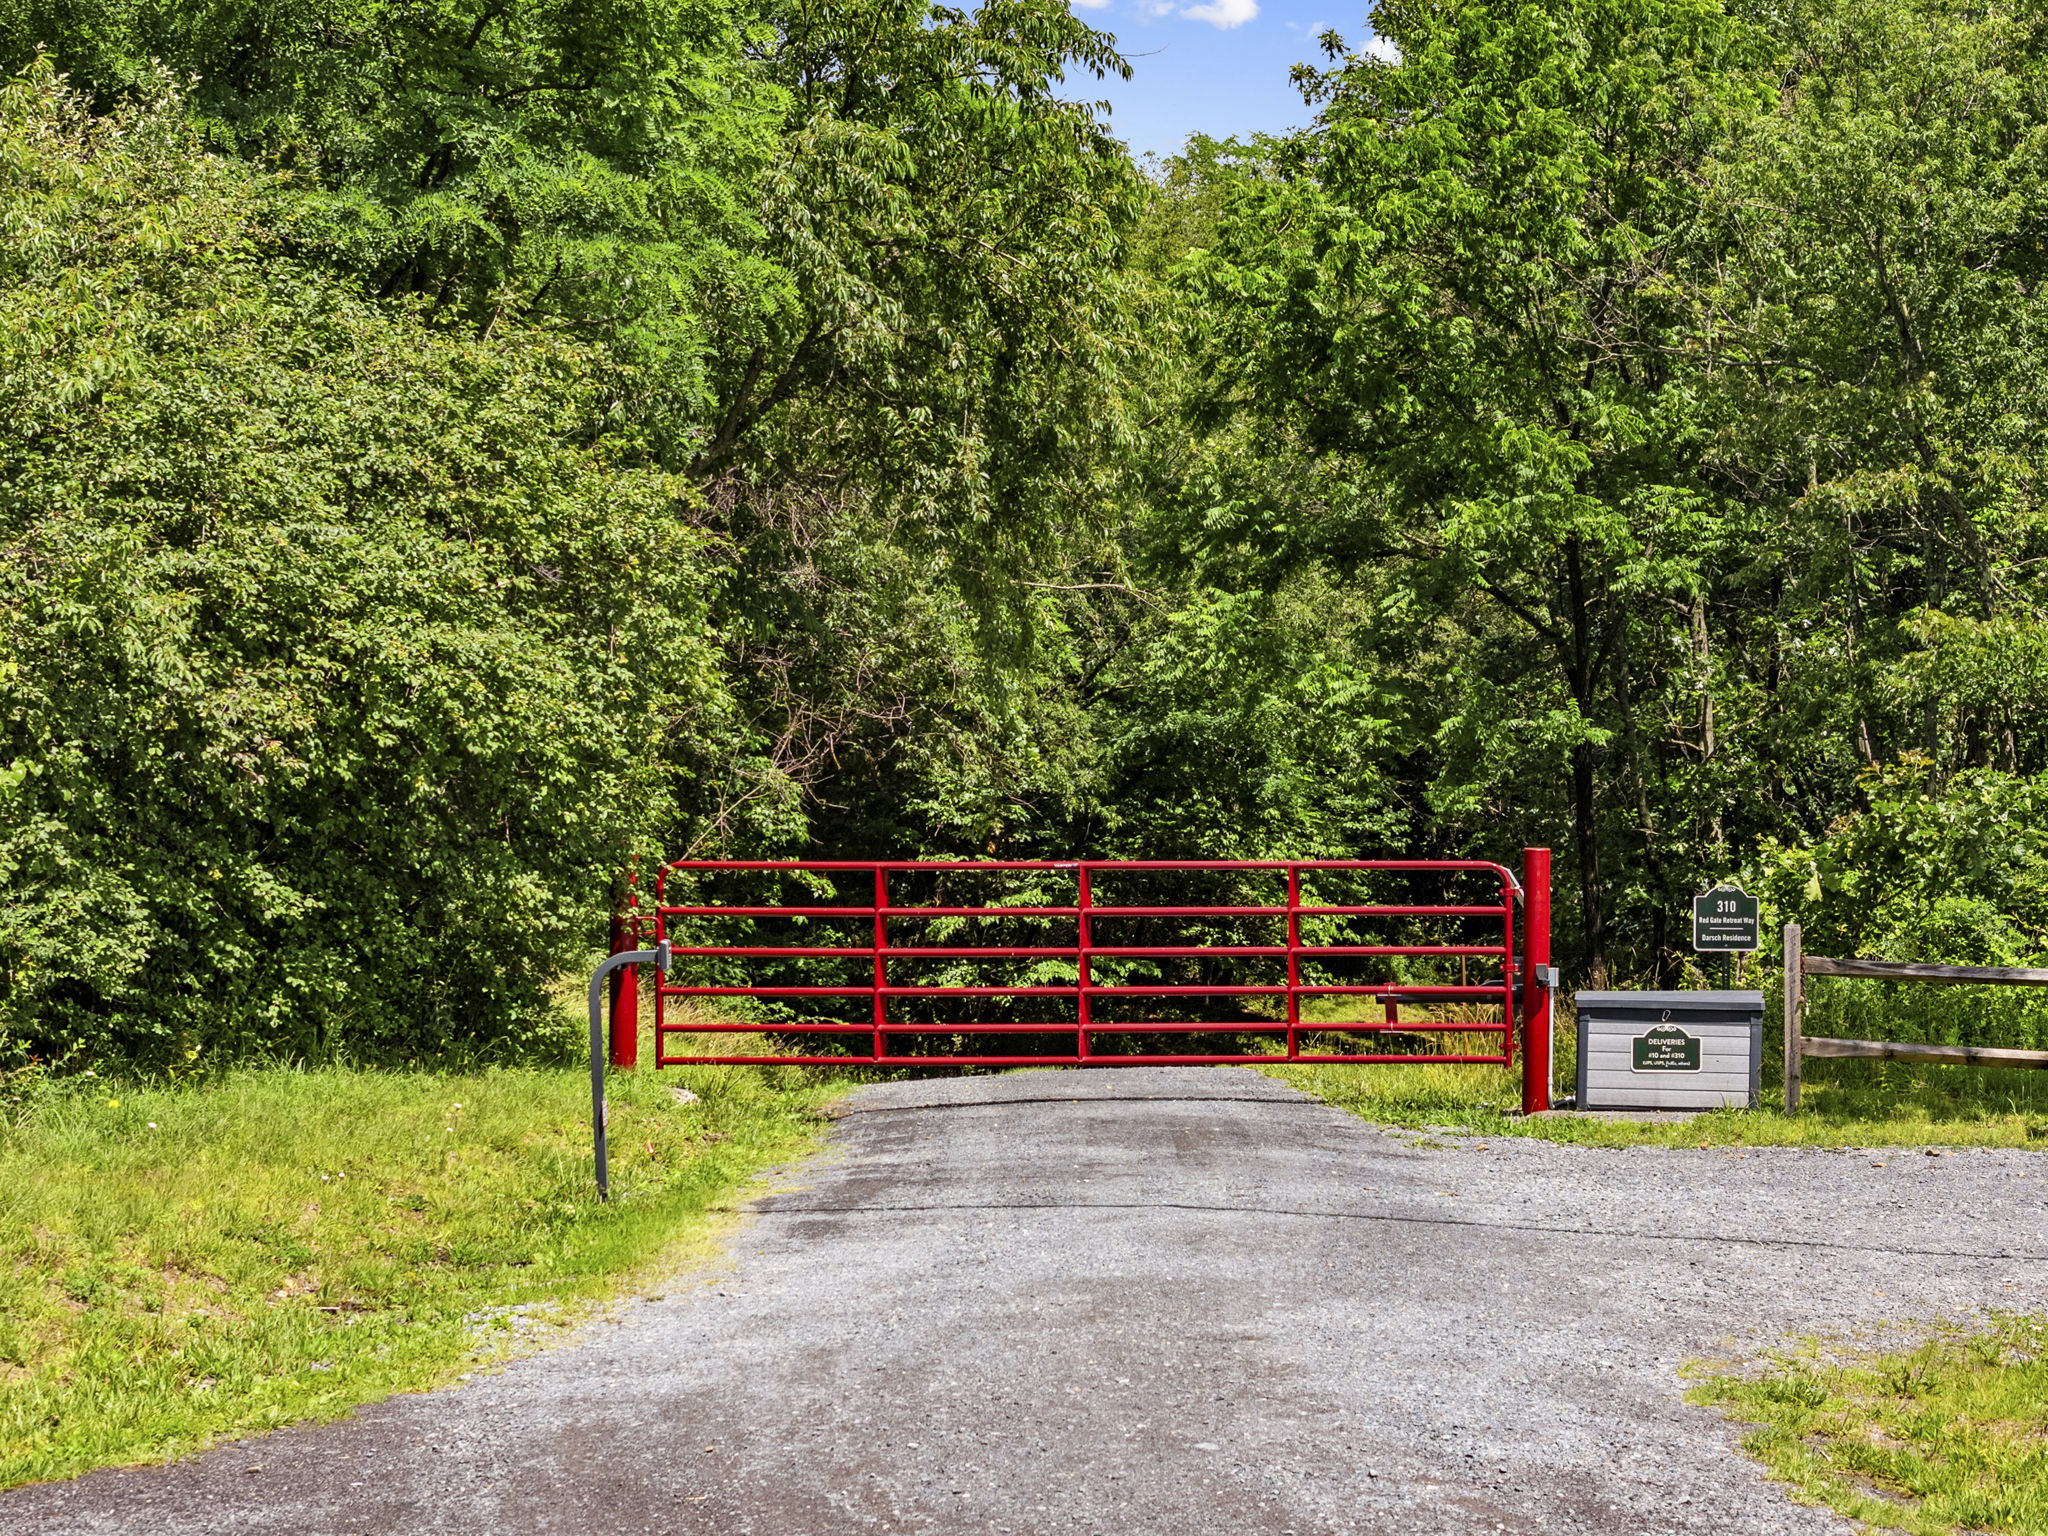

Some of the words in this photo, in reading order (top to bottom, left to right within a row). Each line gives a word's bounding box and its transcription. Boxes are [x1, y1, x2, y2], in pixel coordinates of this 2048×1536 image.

[1716, 900, 1737, 913] 310
[1743, 917, 1755, 925] Way
[1722, 934, 1751, 942] Residence
